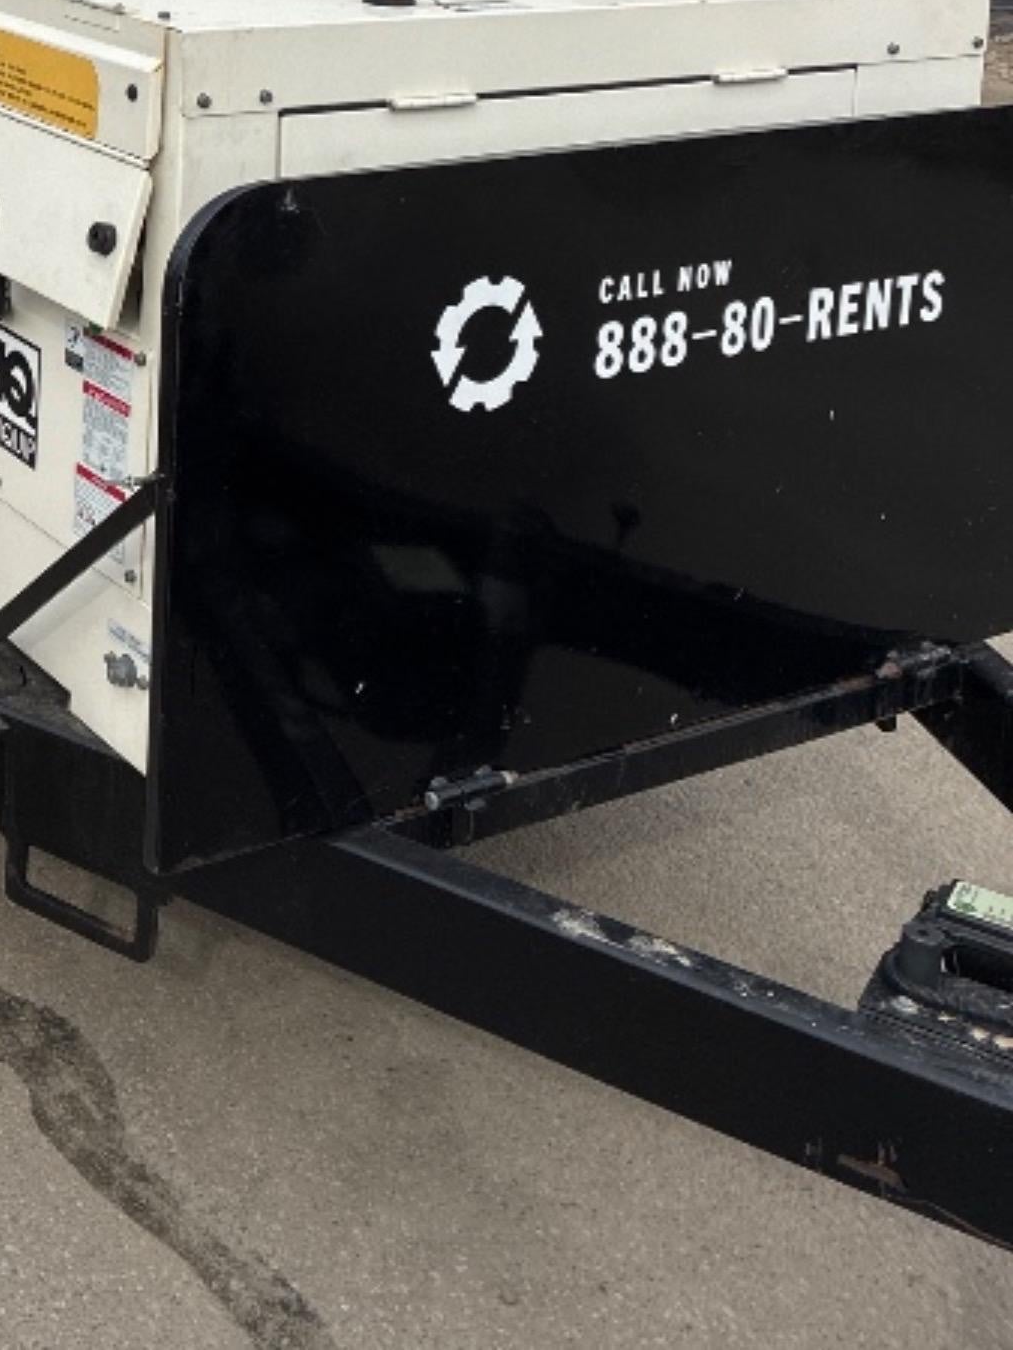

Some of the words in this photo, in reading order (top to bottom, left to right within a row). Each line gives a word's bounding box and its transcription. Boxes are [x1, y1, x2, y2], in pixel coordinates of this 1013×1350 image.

[598, 270, 664, 305] CALL
[676, 259, 733, 293] NOW
[593, 269, 947, 380] 888-80-RENTS
